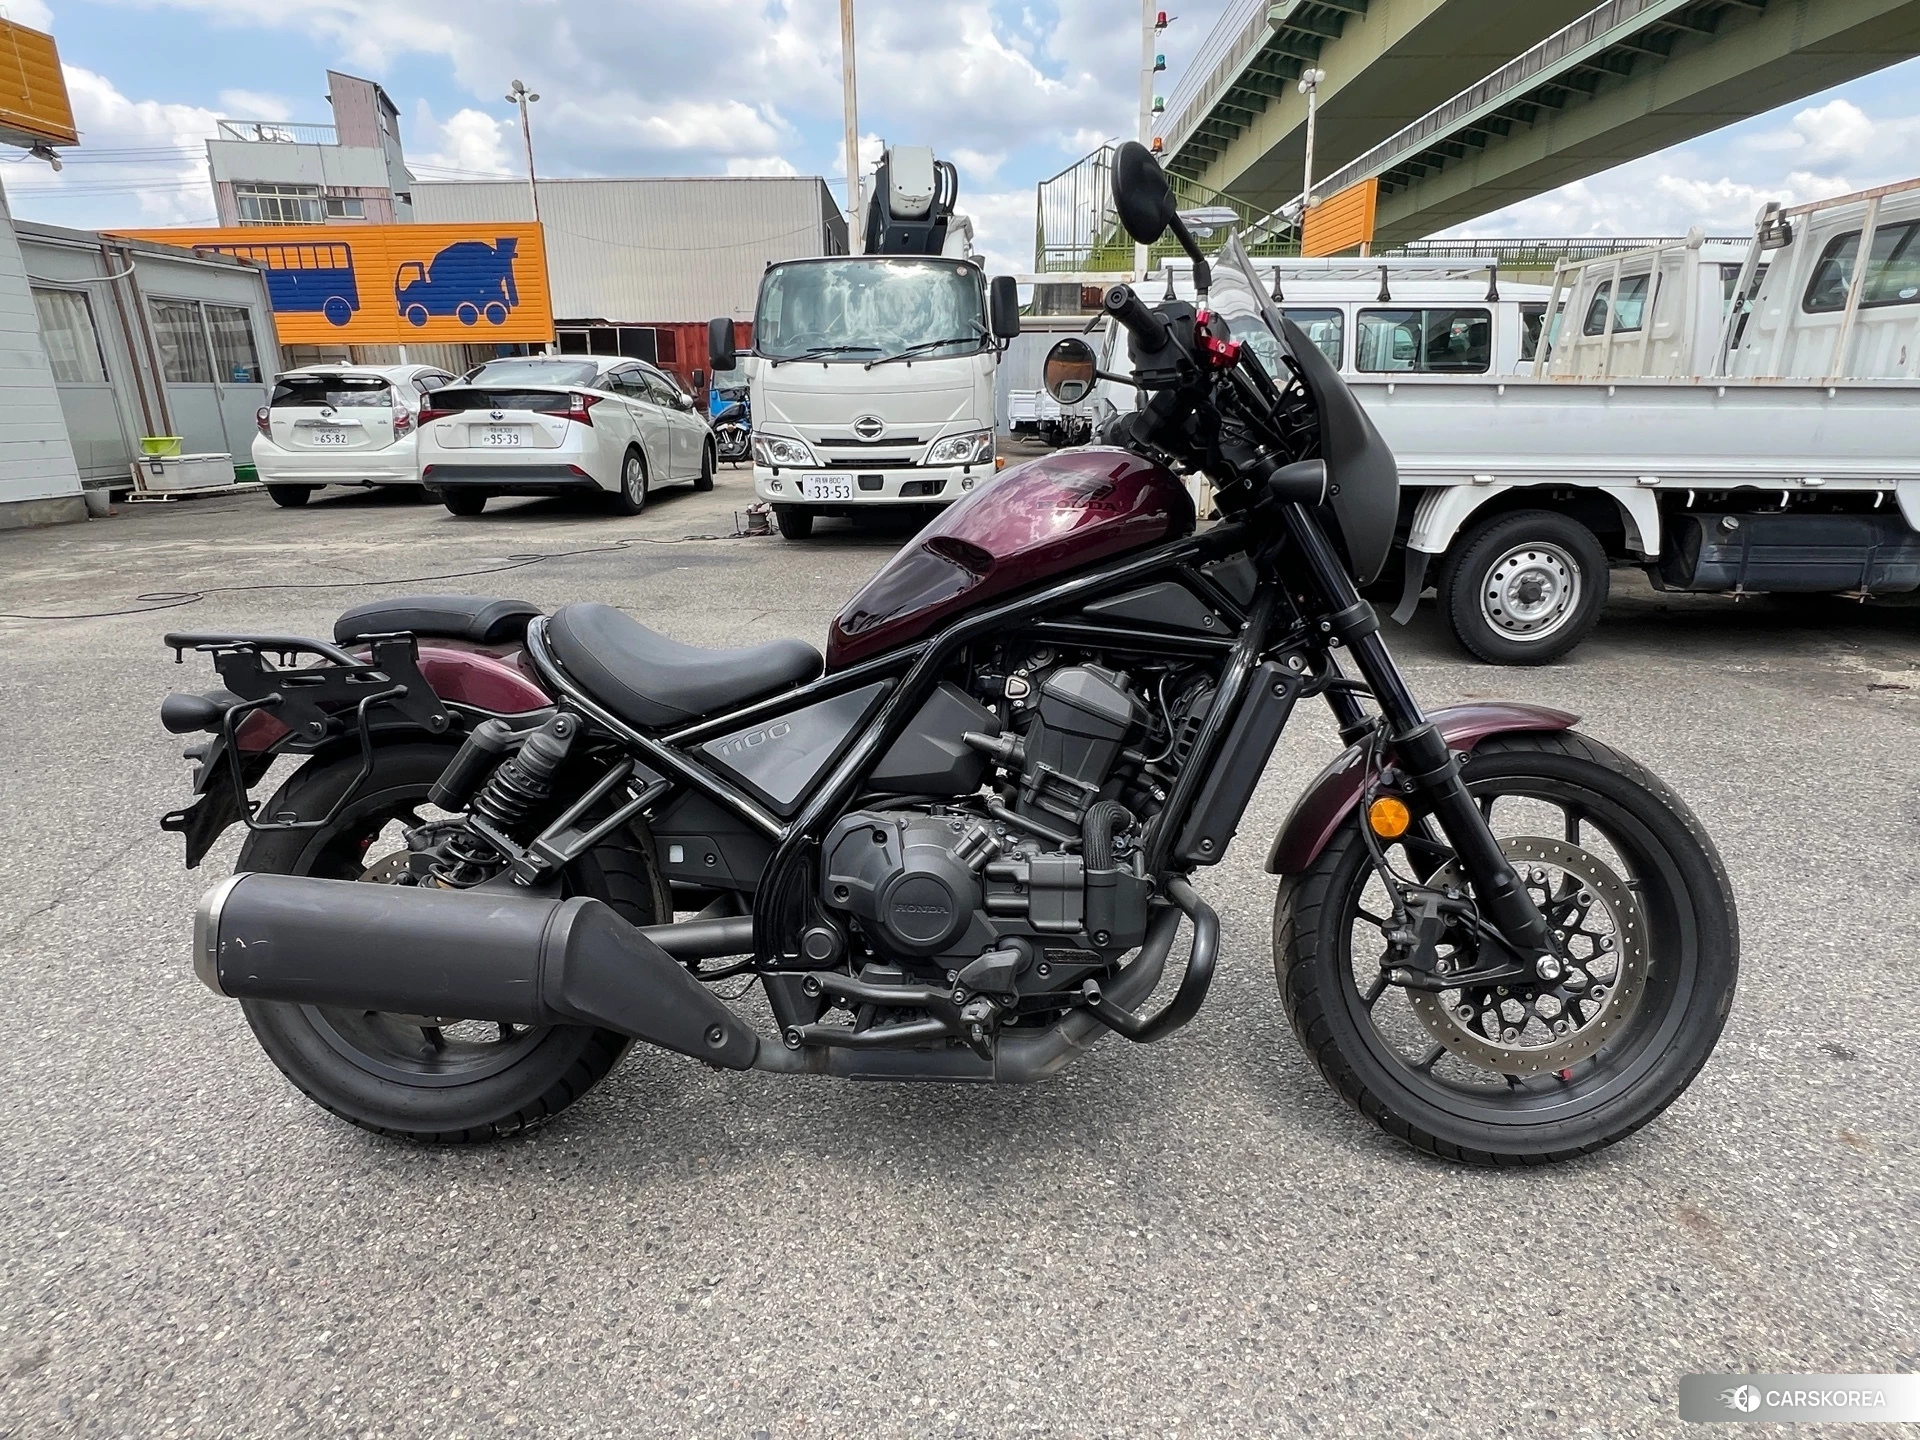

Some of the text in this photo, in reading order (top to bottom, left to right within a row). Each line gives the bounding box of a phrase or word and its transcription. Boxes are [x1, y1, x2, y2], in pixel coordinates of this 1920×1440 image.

[320, 434, 347, 443] 65-82
[490, 434, 519, 444] 95-39
[814, 485, 850, 499] 33-53
[716, 721, 791, 756] 1100
[894, 903, 949, 914] HONDA
